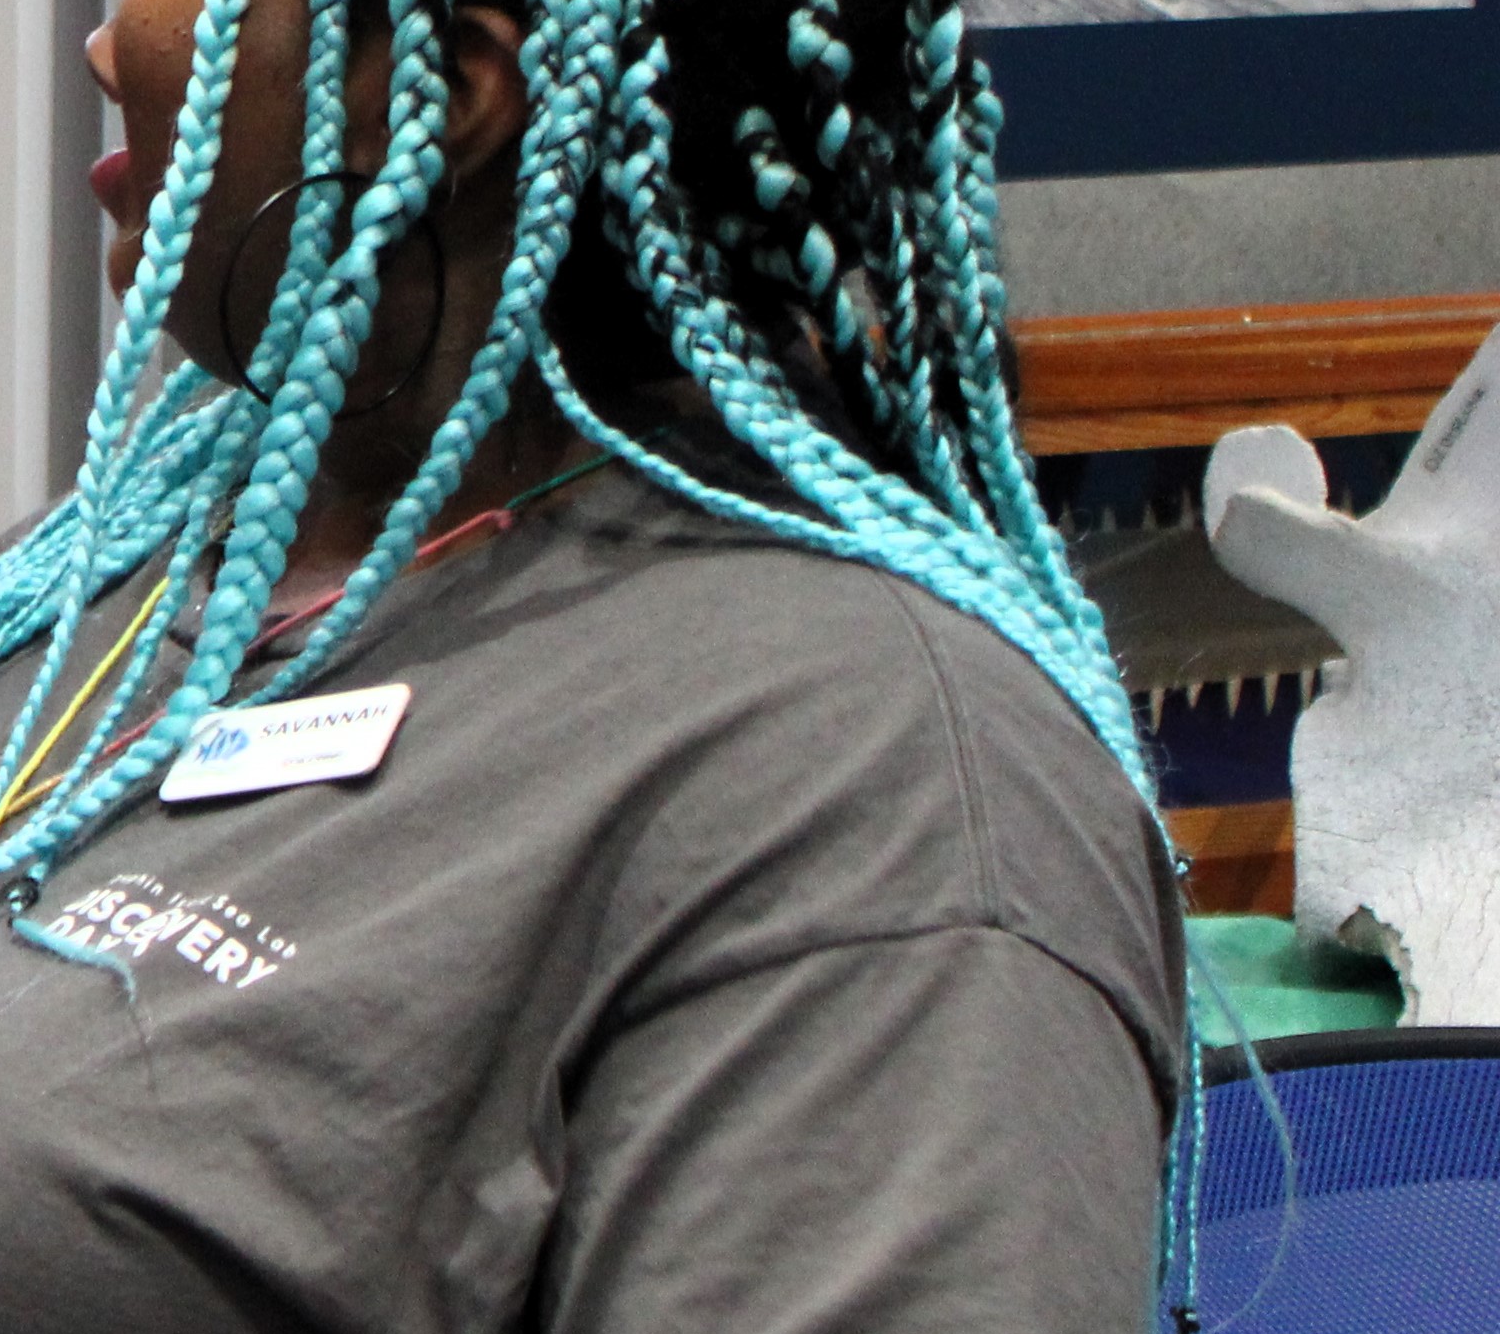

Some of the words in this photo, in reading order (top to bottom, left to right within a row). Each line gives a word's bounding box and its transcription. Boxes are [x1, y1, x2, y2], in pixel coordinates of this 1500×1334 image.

[261, 704, 388, 739] SAVANNAH
[212, 893, 252, 929] Sea
[256, 925, 297, 960] Lab
